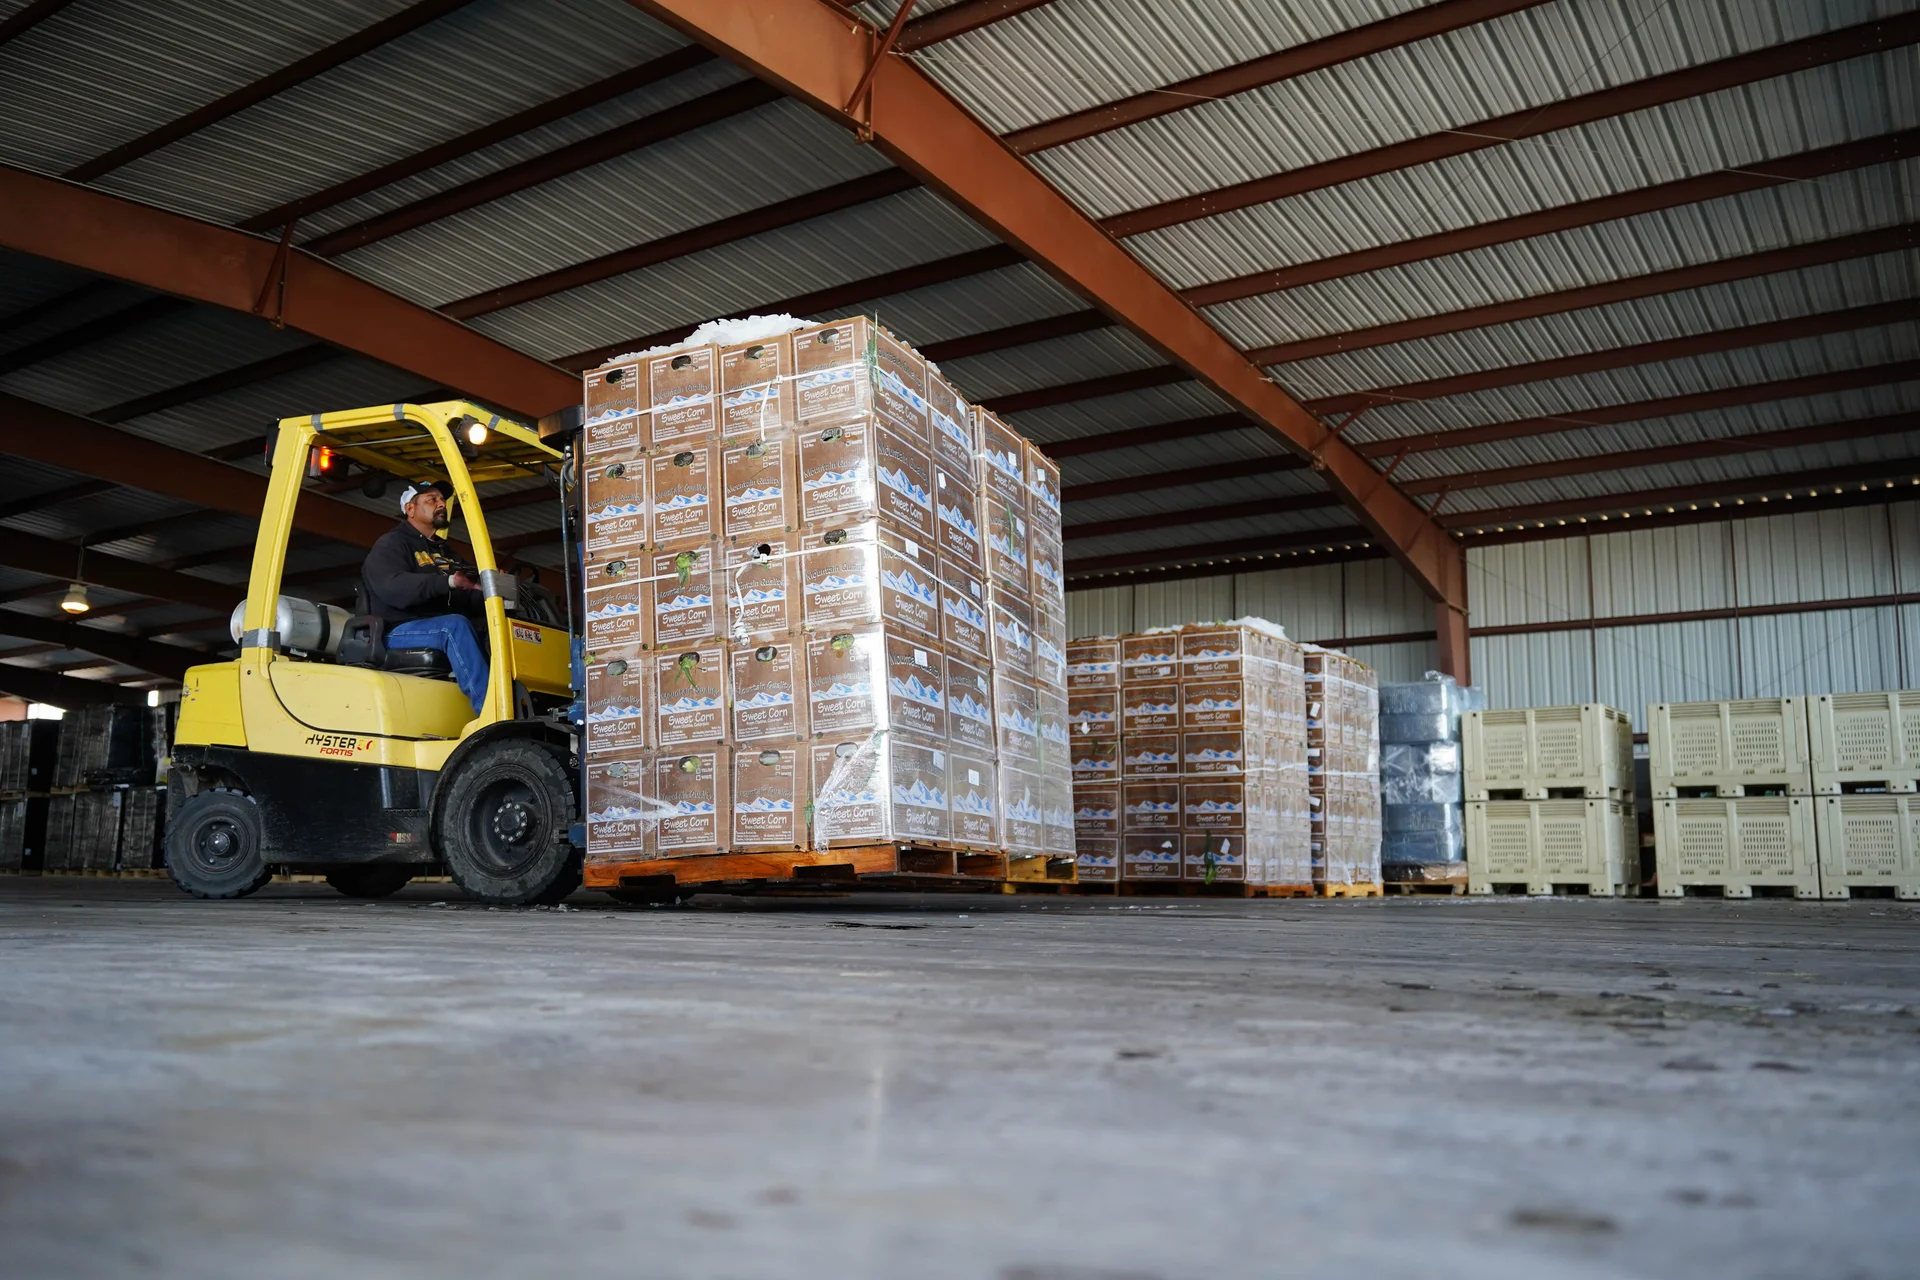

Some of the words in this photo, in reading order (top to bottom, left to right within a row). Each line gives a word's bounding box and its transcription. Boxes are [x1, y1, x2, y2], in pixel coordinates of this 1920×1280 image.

[804, 390, 829, 401] Sweet
[831, 384, 849, 394] Corn
[662, 412, 684, 423] Sweet
[687, 407, 705, 417] Corn
[729, 407, 753, 418] Sweet
[885, 392, 904, 414] Sweet
[905, 405, 919, 424] Corn
[592, 425, 613, 437] Sweet
[616, 422, 633, 431] Corn
[757, 478, 780, 486] Quality
[813, 489, 837, 501] Sweet
[732, 506, 756, 517] Sweet
[758, 502, 776, 511] Corn
[891, 492, 909, 513] Sweet
[910, 503, 923, 521] Corn
[660, 512, 683, 523] Sweet
[685, 508, 703, 518] Corn
[595, 521, 617, 532] Sweet
[619, 518, 637, 528] Corn
[949, 527, 963, 546] Sweet
[964, 536, 974, 553] Corn
[806, 567, 839, 580] Mountain
[761, 578, 784, 588] Quality
[815, 592, 841, 605] Sweet
[843, 590, 863, 600] Corn
[761, 604, 780, 613] Corn
[895, 595, 914, 615] Sweet
[915, 604, 928, 621] Corn
[592, 621, 615, 632] Sweet
[616, 617, 634, 628] Corn
[663, 613, 686, 625] Sweet
[688, 610, 707, 618] Corn
[955, 620, 970, 638] Sweet
[971, 628, 980, 643] Corn
[1193, 664, 1213, 672] Sweet
[1214, 662, 1229, 670] Corn
[767, 681, 792, 691] Quality
[618, 695, 640, 705] Quality
[818, 702, 843, 713] Sweet
[846, 698, 866, 709] Corn
[669, 715, 694, 726] Sweet
[695, 712, 714, 722] Corn
[742, 710, 766, 722] Sweet
[768, 708, 788, 718] Corn
[903, 701, 921, 719] Sweet
[922, 707, 935, 723] Corn
[1195, 713, 1213, 721] Sweet
[593, 724, 616, 734] Sweet
[618, 721, 636, 731] Corn
[960, 719, 975, 734] Sweet
[976, 723, 985, 737] Corn
[305, 734, 356, 749] HYSTER
[320, 747, 353, 756] FORTIS
[741, 815, 766, 825] Sweet
[768, 814, 787, 824] Corn
[852, 807, 874, 818] Corn
[906, 808, 926, 824] Sweet
[927, 811, 939, 826] Corn
[1154, 814, 1168, 822] Corn
[1217, 814, 1232, 822] Corn
[618, 822, 636, 831] Corn
[664, 818, 688, 830] Sweet
[690, 817, 709, 827] Corn
[964, 816, 979, 830] Sweet
[980, 819, 989, 832] Corn
[1154, 864, 1169, 872] Corn
